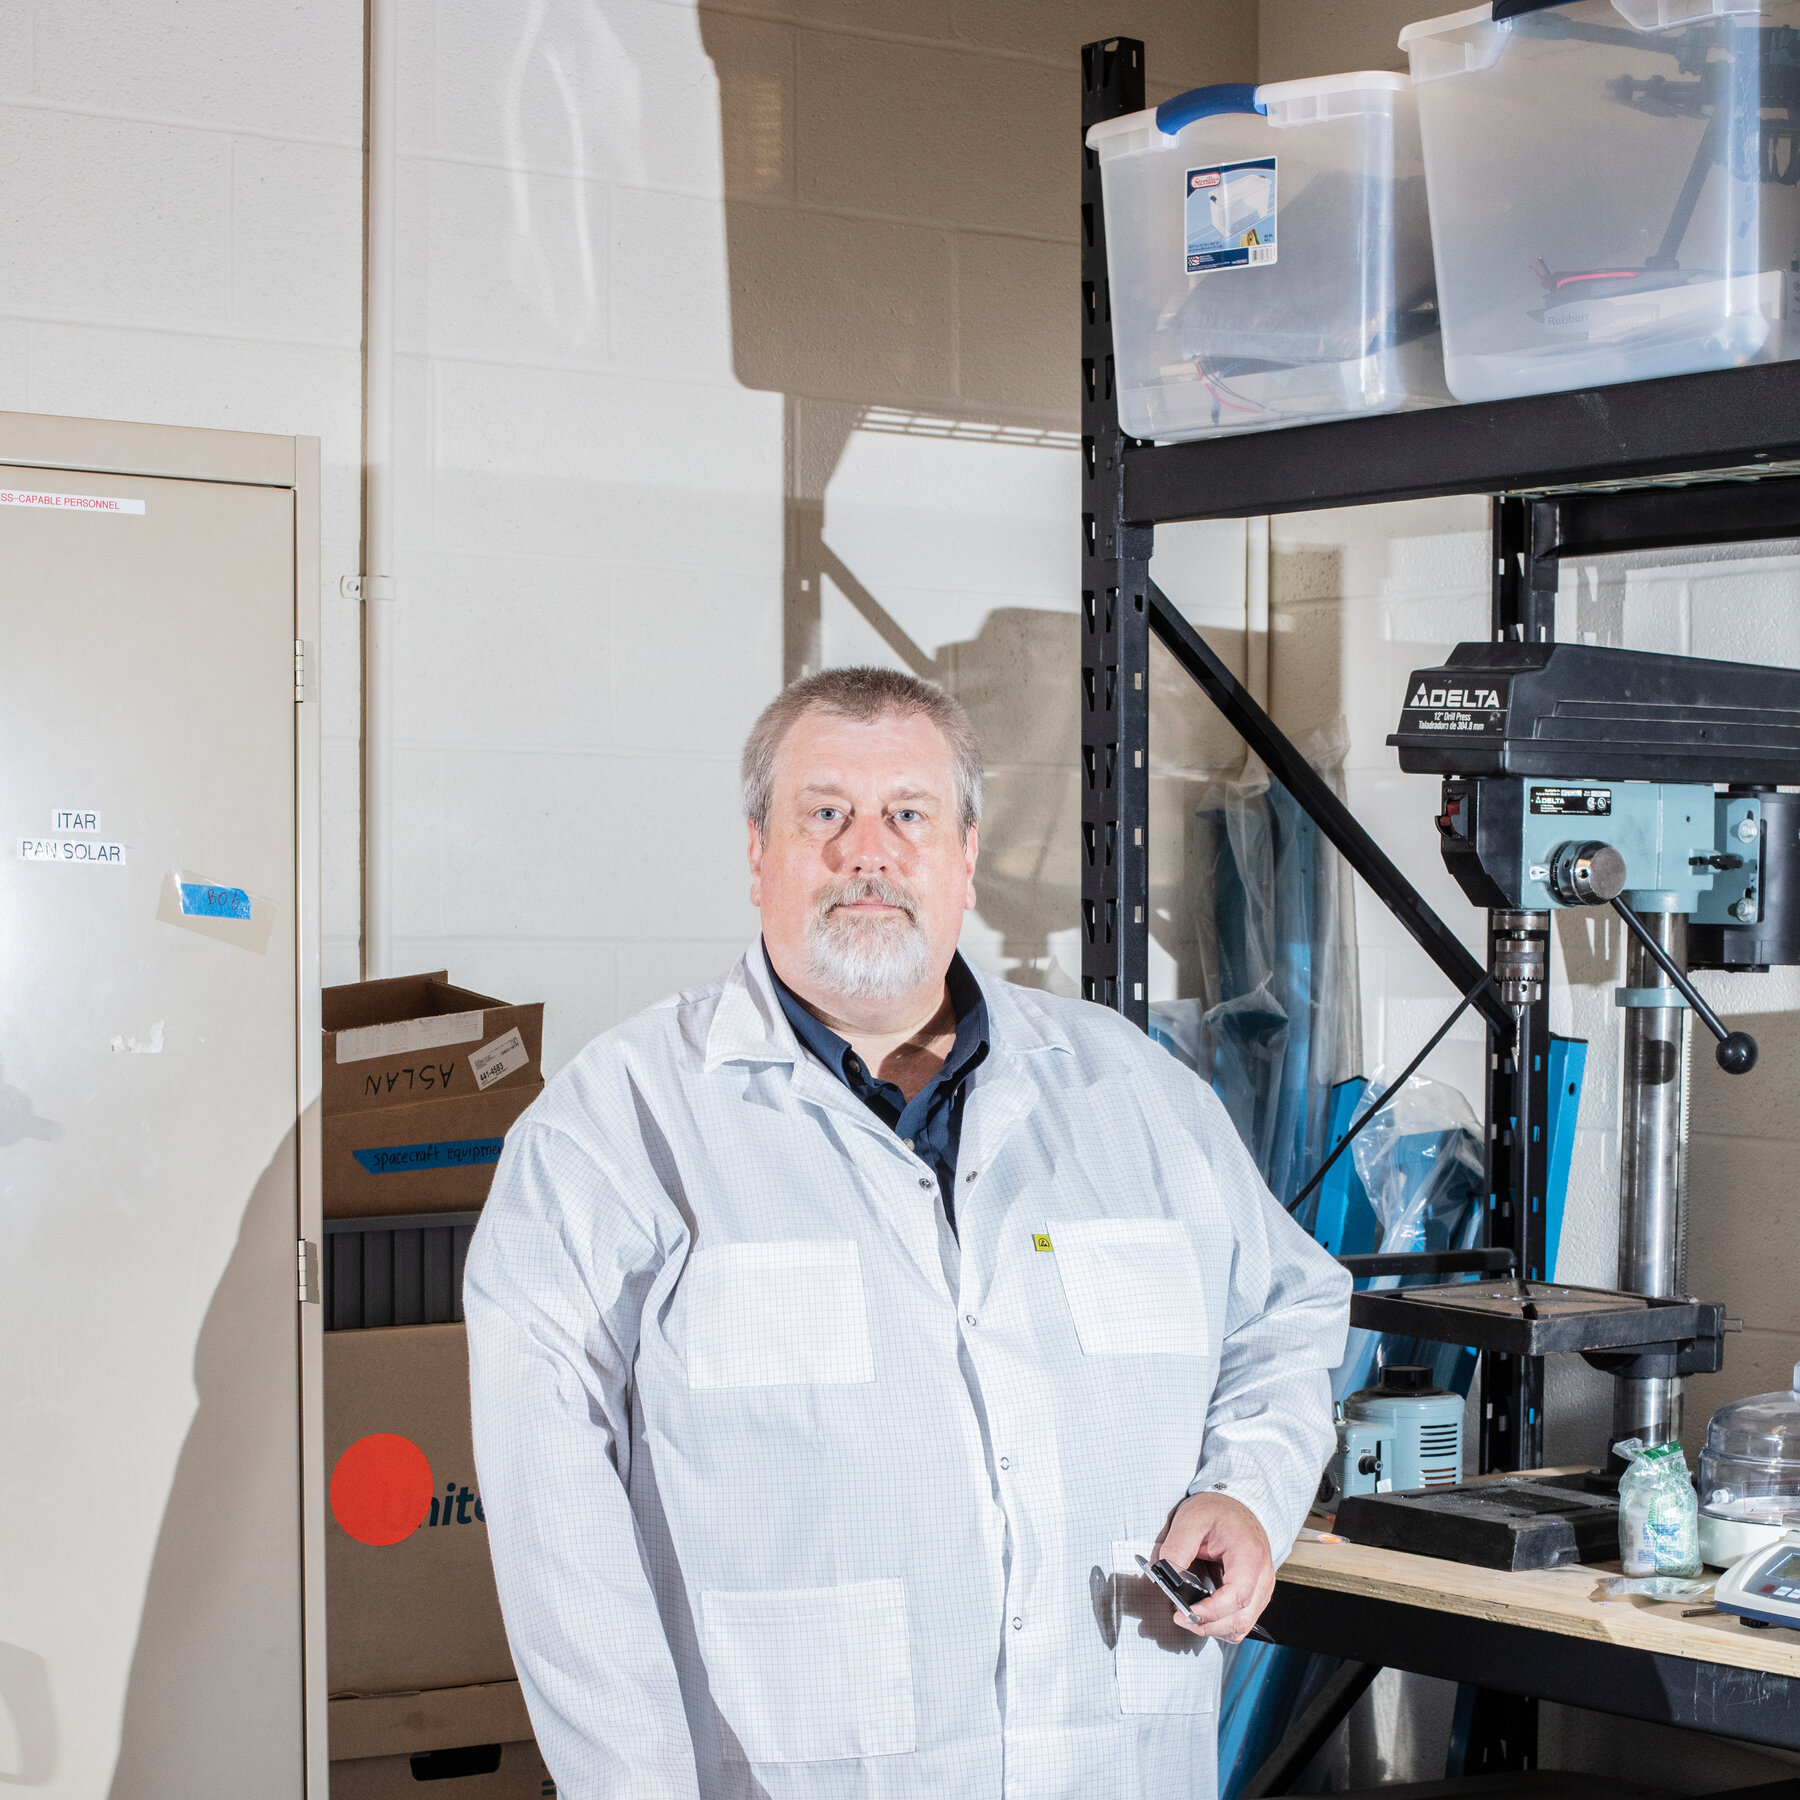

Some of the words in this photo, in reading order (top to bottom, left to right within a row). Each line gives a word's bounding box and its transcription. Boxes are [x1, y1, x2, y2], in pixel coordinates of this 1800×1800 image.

[64, 497, 120, 510] PERSONNEL
[1429, 689, 1500, 708] DELTA
[1444, 711, 1456, 721] Drill
[1456, 712, 1471, 721] Press
[58, 812, 96, 829] ITAR
[22, 841, 57, 858] PAN
[63, 843, 120, 861] SOLAR
[373, 1145, 440, 1171] spacecraft
